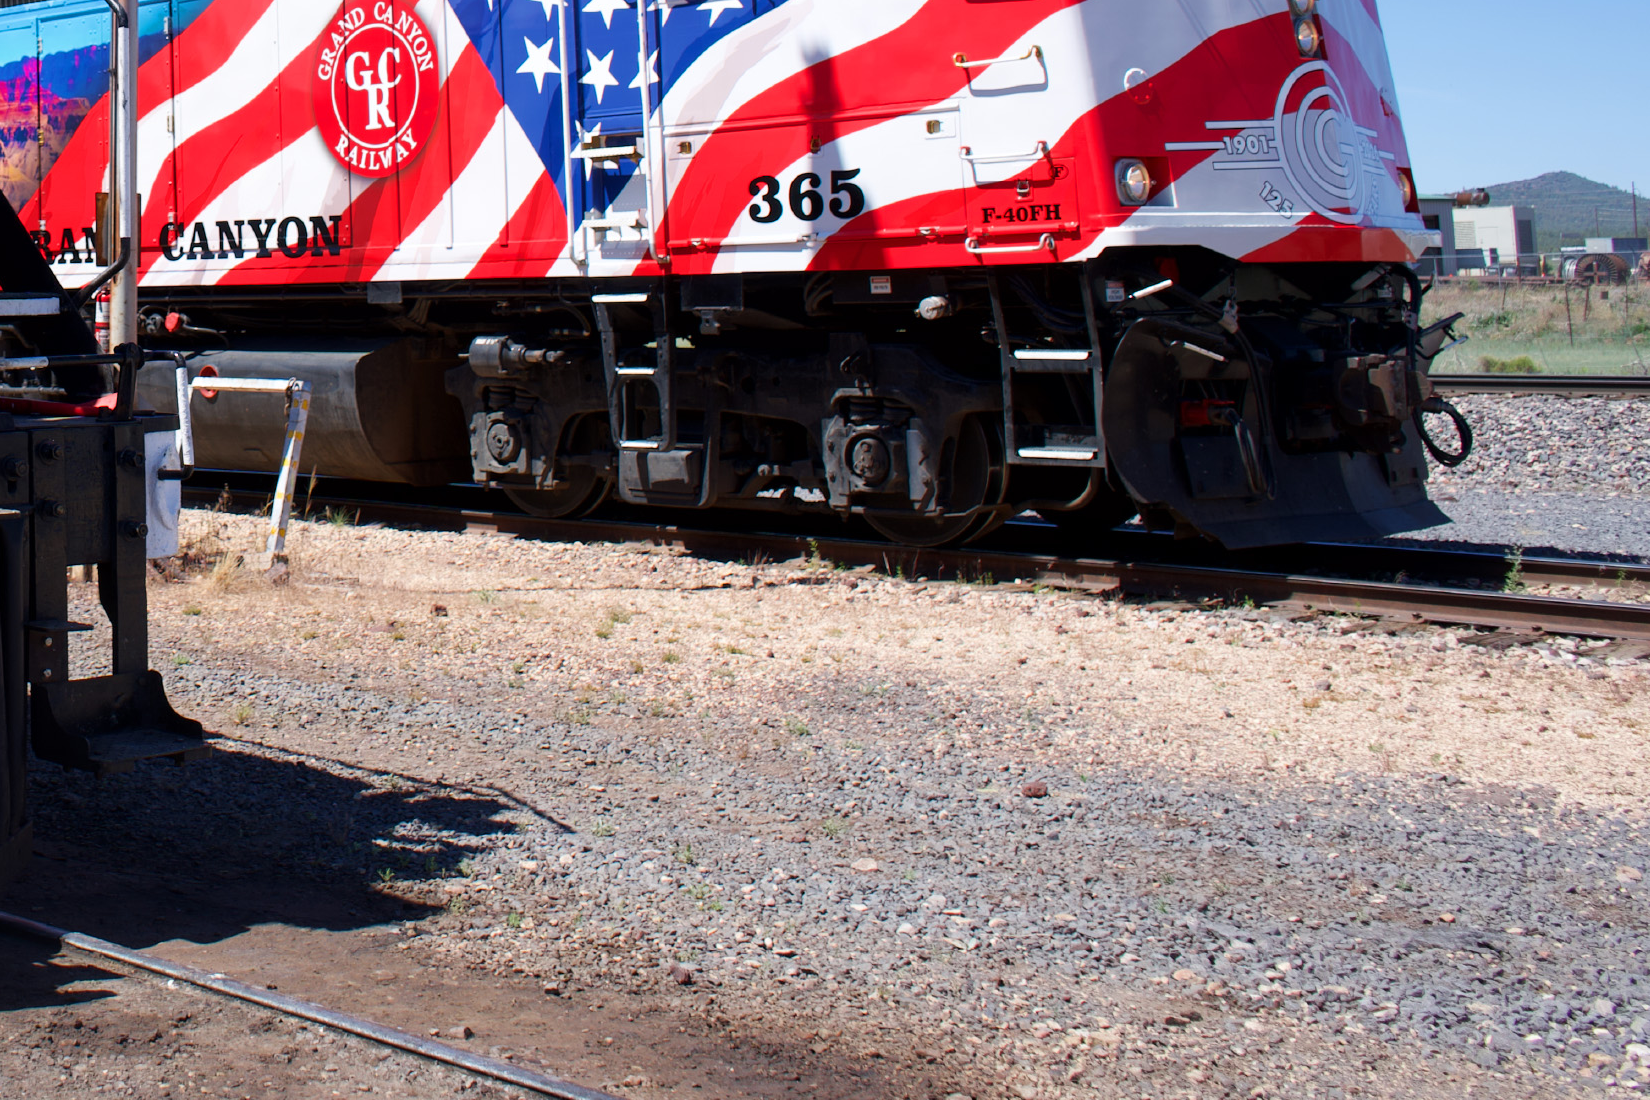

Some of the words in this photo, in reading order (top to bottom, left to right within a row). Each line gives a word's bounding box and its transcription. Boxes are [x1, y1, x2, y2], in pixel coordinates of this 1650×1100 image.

[318, 7, 365, 80] GRAND
[374, 2, 433, 72] CANYON
[335, 128, 417, 170] RAILWAY
[1223, 135, 1269, 155] 1901
[749, 168, 865, 223] 365
[982, 204, 1061, 223] F-40FH
[1259, 181, 1294, 219] 125
[159, 215, 342, 261] CANYON
